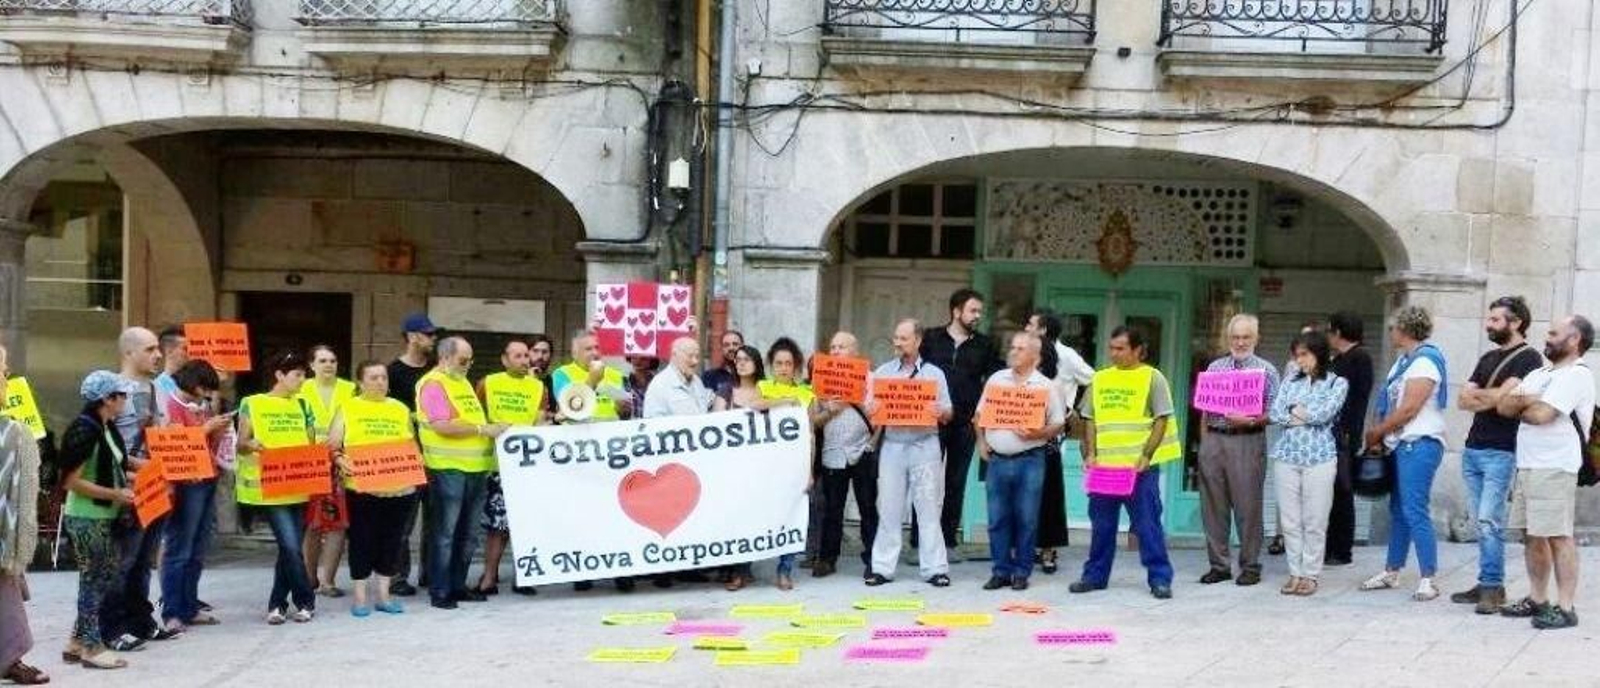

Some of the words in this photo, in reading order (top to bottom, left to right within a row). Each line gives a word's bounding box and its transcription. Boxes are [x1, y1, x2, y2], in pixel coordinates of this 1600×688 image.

[503, 411, 800, 469] Pongámoslle
[517, 547, 545, 578] Á
[552, 549, 633, 573] Nova
[643, 525, 804, 566] Corporación
